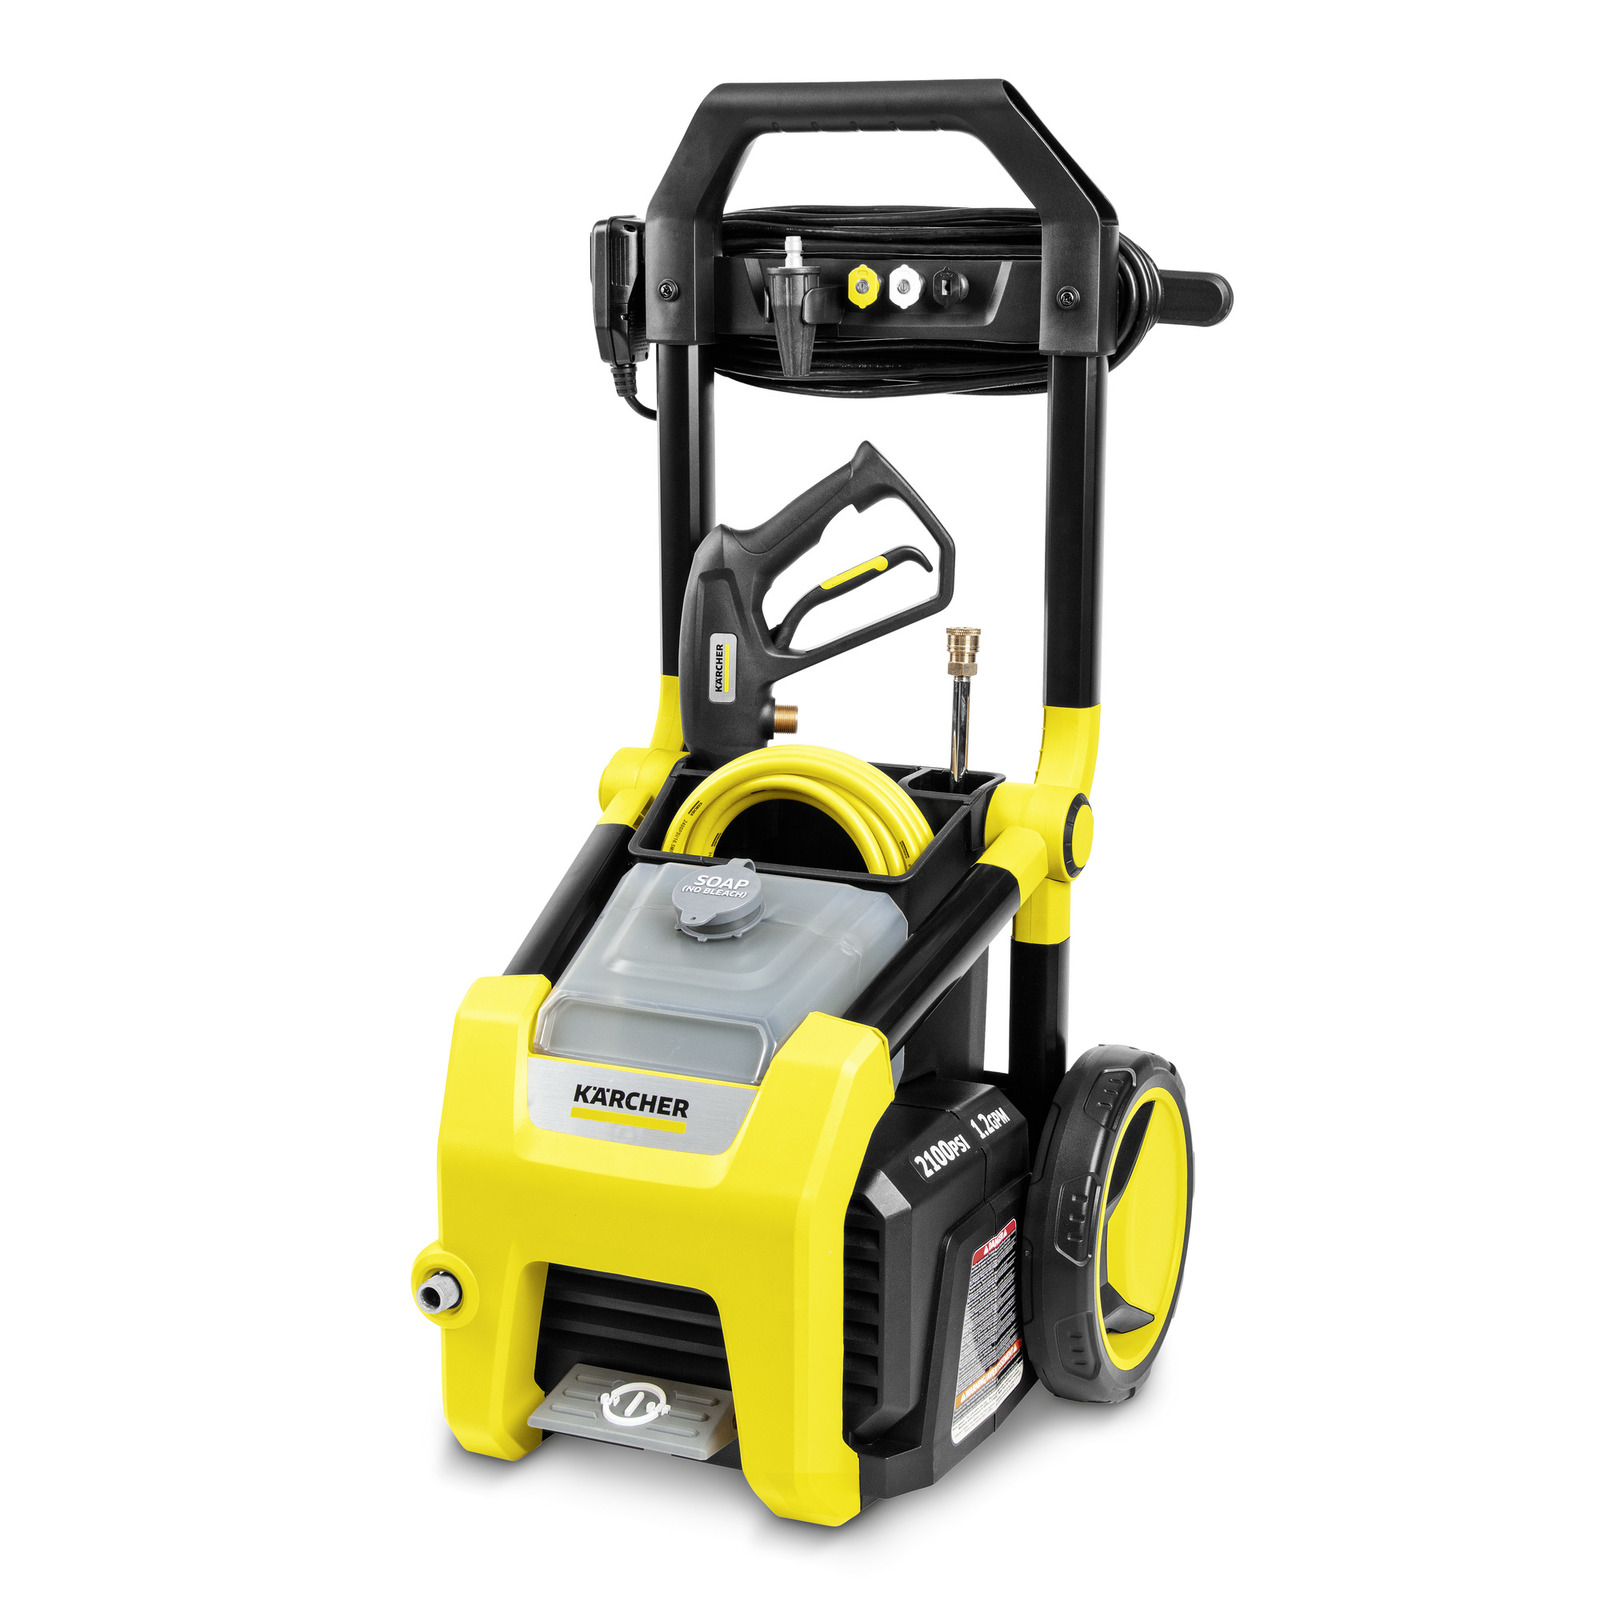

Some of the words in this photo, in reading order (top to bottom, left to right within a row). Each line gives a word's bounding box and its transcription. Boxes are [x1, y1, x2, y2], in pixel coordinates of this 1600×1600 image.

[715, 644, 724, 693] KÄRCHER
[682, 885, 702, 893] (NO
[703, 887, 747, 899] BLEACH)
[694, 874, 750, 890] SOAP
[574, 1084, 690, 1118] KÄRCHER
[914, 1134, 971, 1178] 2100PSI
[970, 1107, 1011, 1139] 1.2GPM
